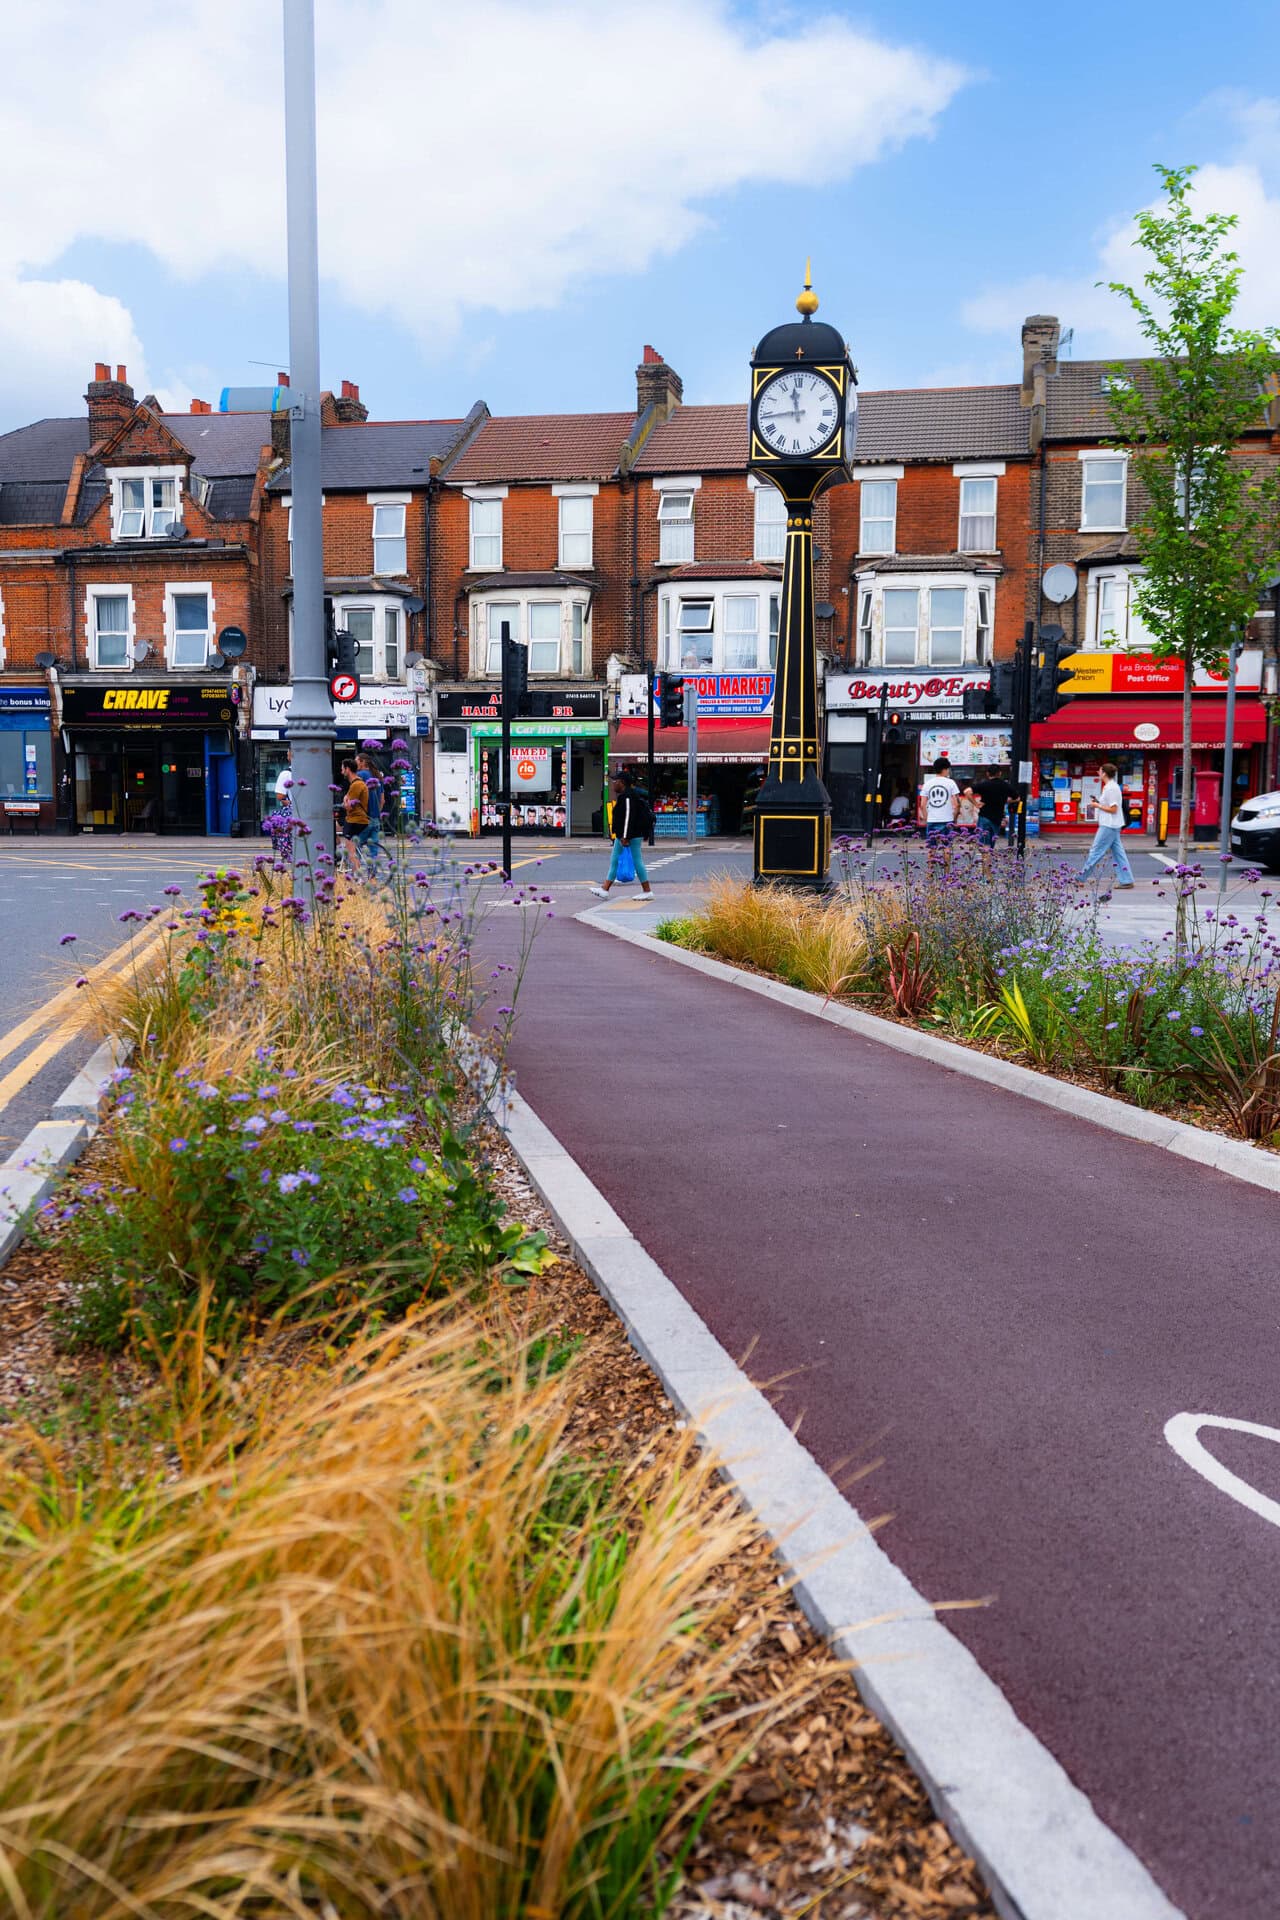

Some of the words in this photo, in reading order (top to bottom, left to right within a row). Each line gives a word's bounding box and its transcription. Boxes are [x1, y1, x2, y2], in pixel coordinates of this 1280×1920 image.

[1127, 674, 1145, 682] Post
[1147, 674, 1170, 682] Office
[720, 676, 772, 696] MARKET
[10, 698, 33, 706] bonus
[34, 698, 51, 707] king
[103, 689, 170, 710] CRRAVE
[383, 698, 415, 706] Fusion
[462, 706, 498, 717] HAIR
[520, 762, 534, 772] ria
